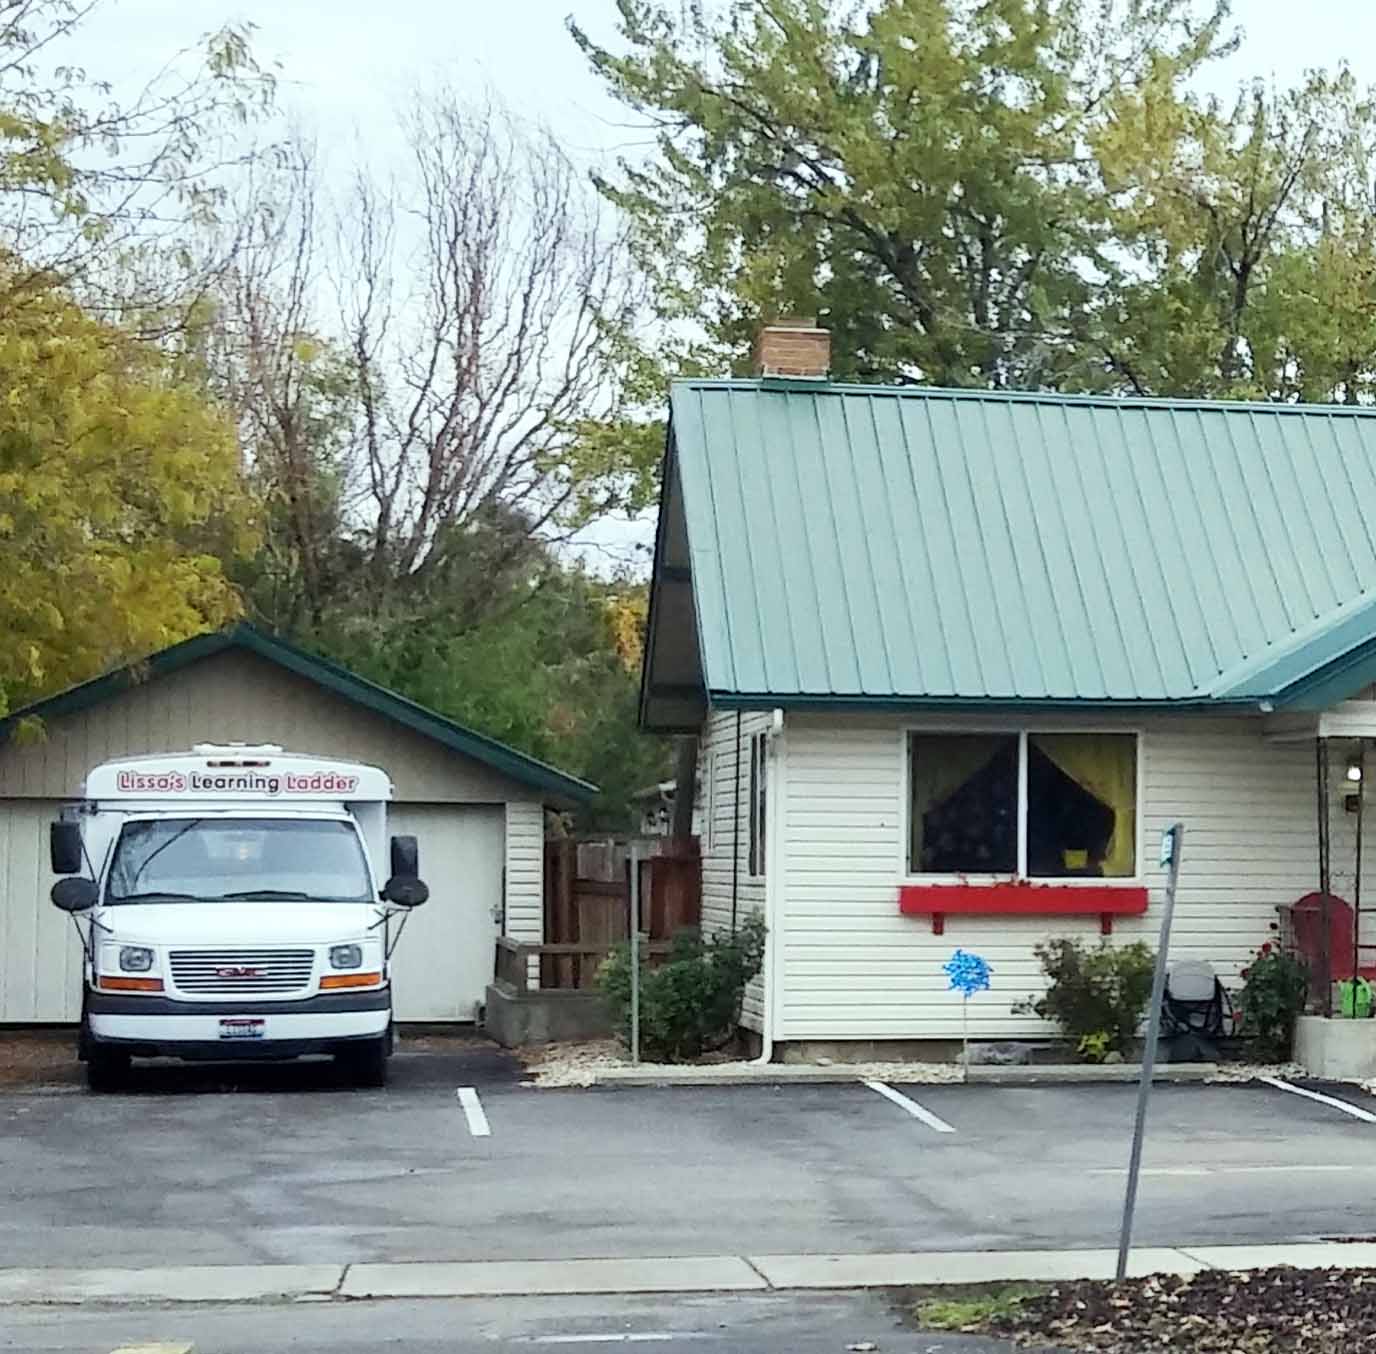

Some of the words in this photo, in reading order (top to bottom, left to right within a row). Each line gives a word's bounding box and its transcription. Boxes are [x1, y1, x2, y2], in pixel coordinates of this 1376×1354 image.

[119, 771, 185, 792] Lissa's
[191, 771, 280, 797] Learning
[286, 772, 358, 792] Ladder
